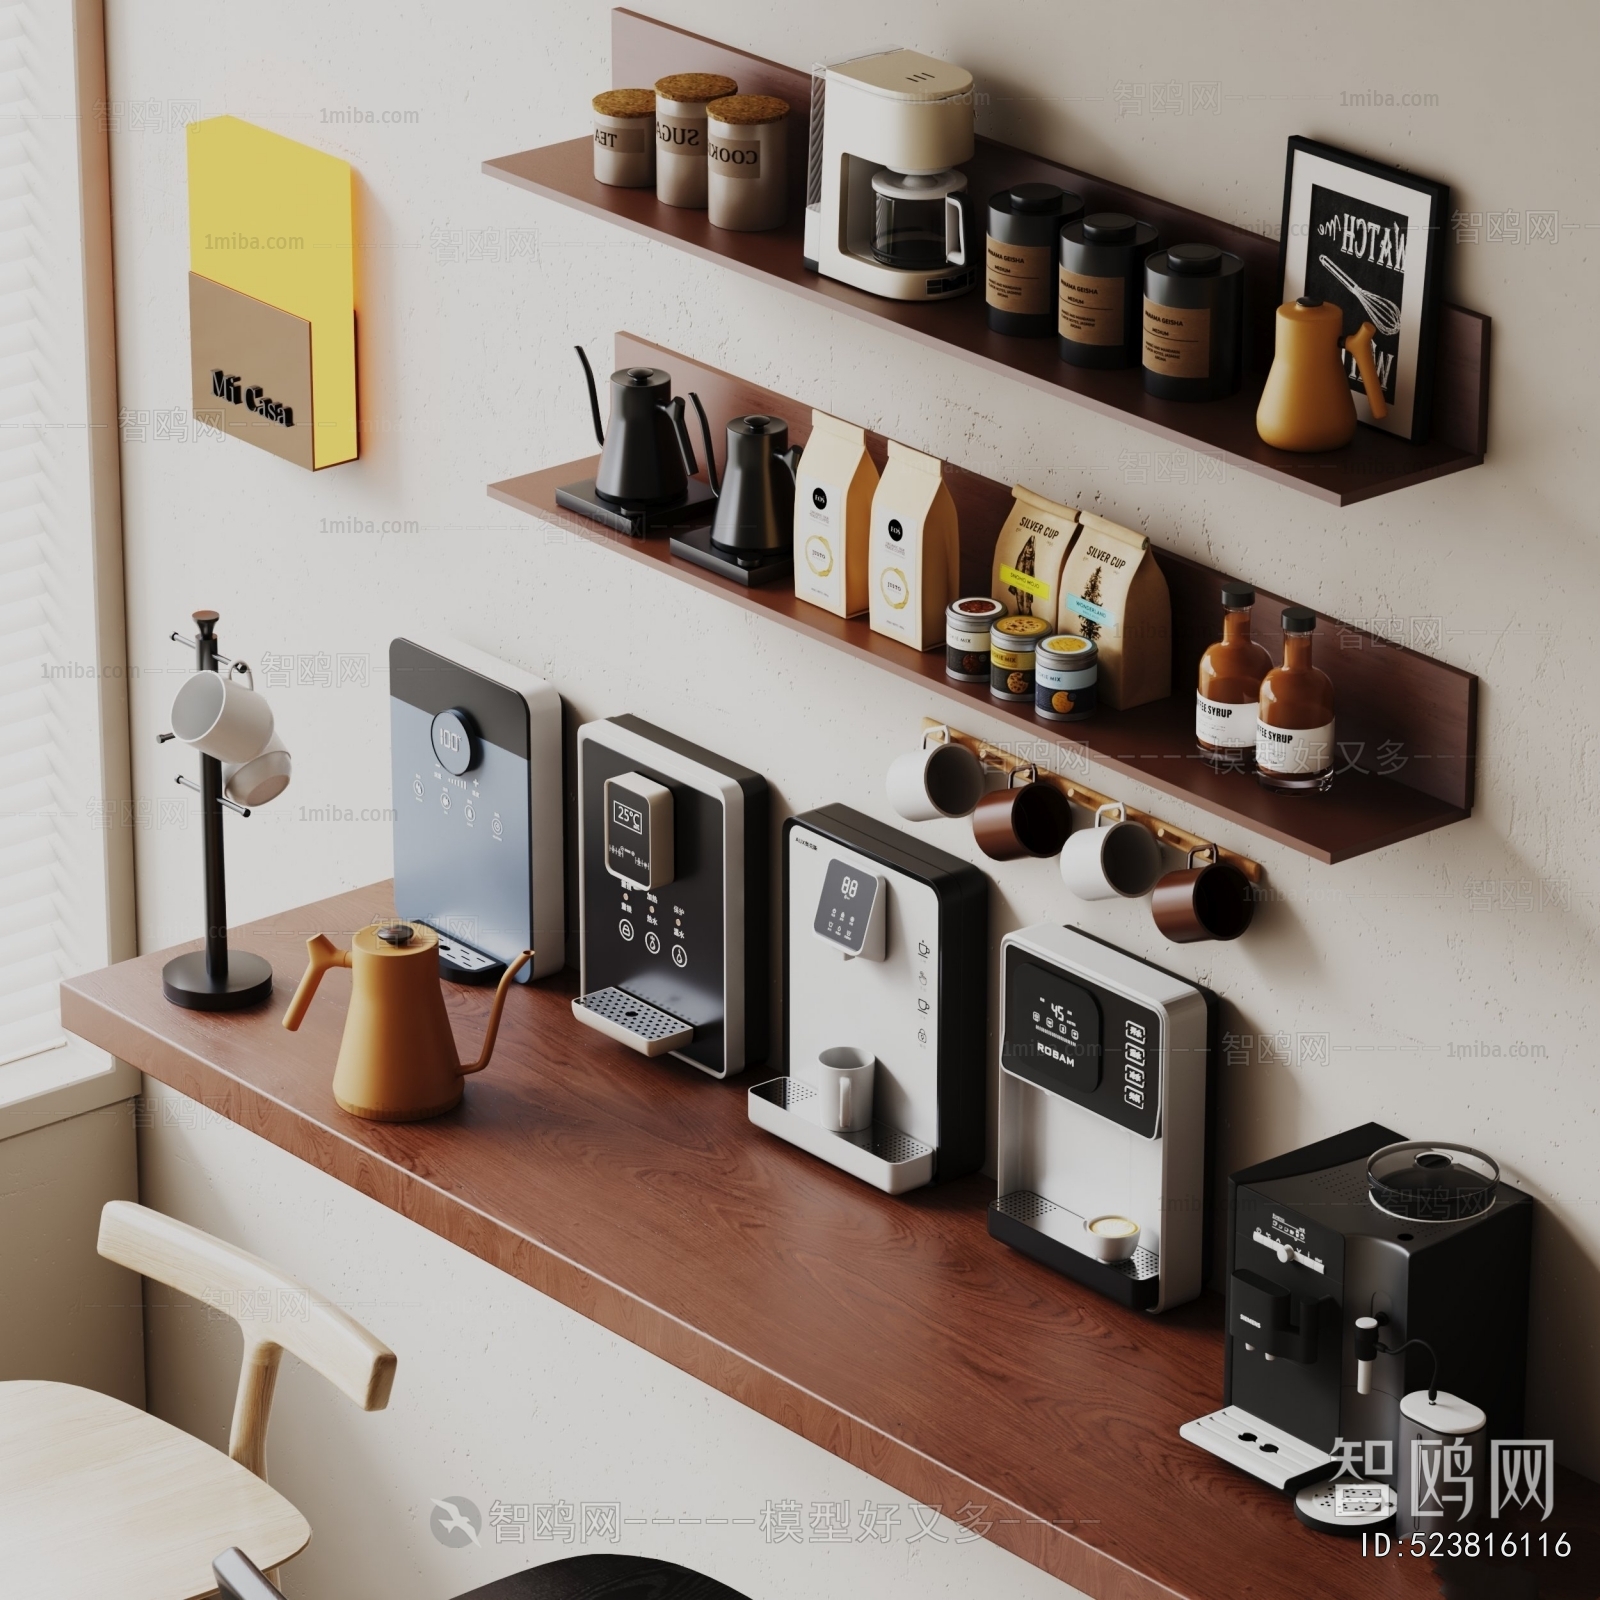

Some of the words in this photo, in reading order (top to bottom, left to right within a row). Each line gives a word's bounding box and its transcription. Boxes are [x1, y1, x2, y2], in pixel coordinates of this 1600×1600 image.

[1003, 255, 1024, 264] GEISHA
[994, 265, 1011, 273] MEDIUM
[1076, 286, 1098, 295] GEISHA
[1067, 296, 1084, 304] MEDIUM
[1161, 318, 1184, 326] GEISHA
[1152, 327, 1169, 336] MEDIUM
[210, 368, 242, 405] Mi
[245, 385, 295, 427] Casa
[1019, 516, 1044, 534] SILVER
[1043, 527, 1060, 540] CUP
[1086, 545, 1110, 563] SILVER
[1110, 556, 1126, 570] CUP
[1075, 600, 1107, 619] WONDERLAND
[1207, 705, 1233, 719] SYRUP
[1268, 731, 1293, 744] SYRUP
[840, 876, 859, 898] 88
[1051, 1002, 1065, 1022] 45
[1037, 1042, 1075, 1068] ROBAM
